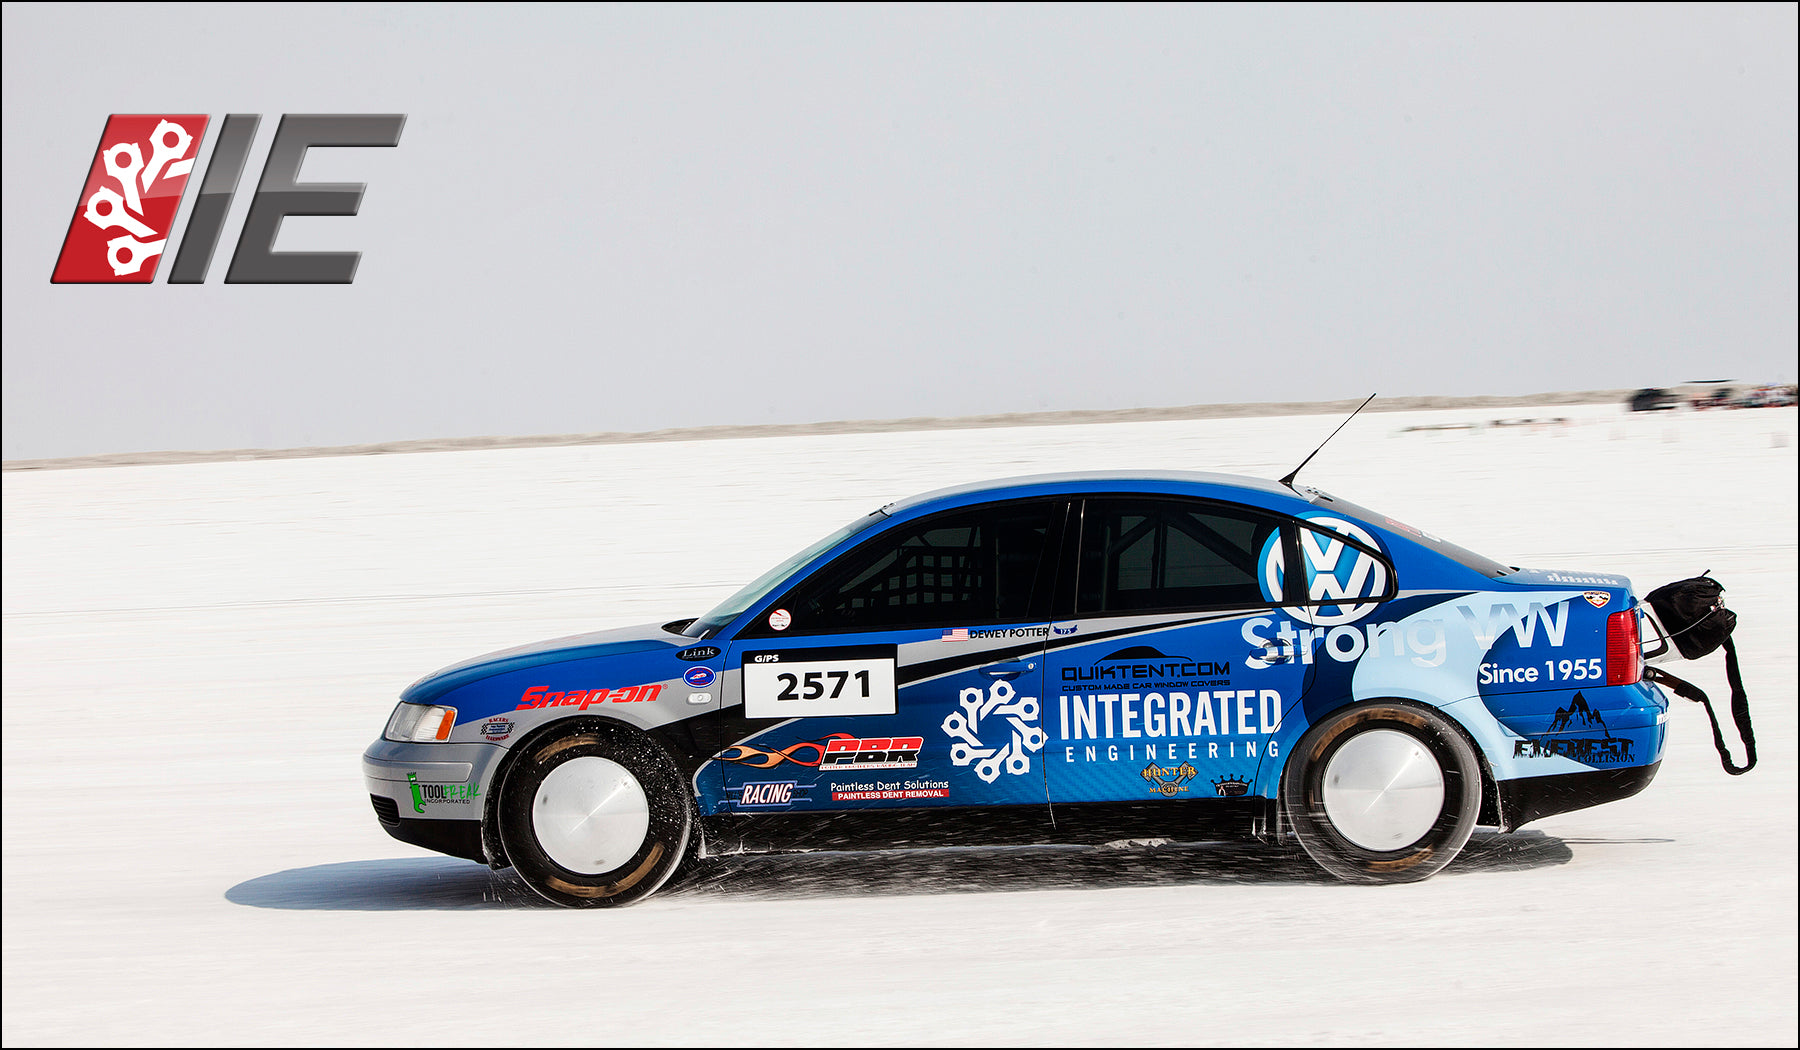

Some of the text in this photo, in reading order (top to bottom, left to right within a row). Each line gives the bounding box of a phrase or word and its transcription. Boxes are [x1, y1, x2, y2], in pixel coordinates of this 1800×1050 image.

[969, 627, 1050, 639] DEWEY POTTER
[1241, 601, 1570, 669] Strong VW
[683, 647, 715, 657] Link
[754, 654, 779, 662] G/PS
[1061, 661, 1231, 683] QUIKTENT.COM
[1478, 658, 1603, 686] Since 1955
[776, 669, 870, 701] 2571
[1062, 679, 1231, 692] CUSTOM MADE CAR WINDOW COVERS
[1059, 689, 1282, 741] INTEGRATED
[820, 736, 924, 766] PBR
[1065, 741, 1279, 763] ENGINEERING
[1513, 738, 1634, 759] EVEREST
[1578, 754, 1636, 763] COLLISION
[1144, 766, 1196, 777] HUNTER
[741, 783, 793, 804] RACING
[831, 779, 949, 792] Paintless Dent Solutions
[838, 790, 944, 800] PAINTLESS DENT REMOVAL
